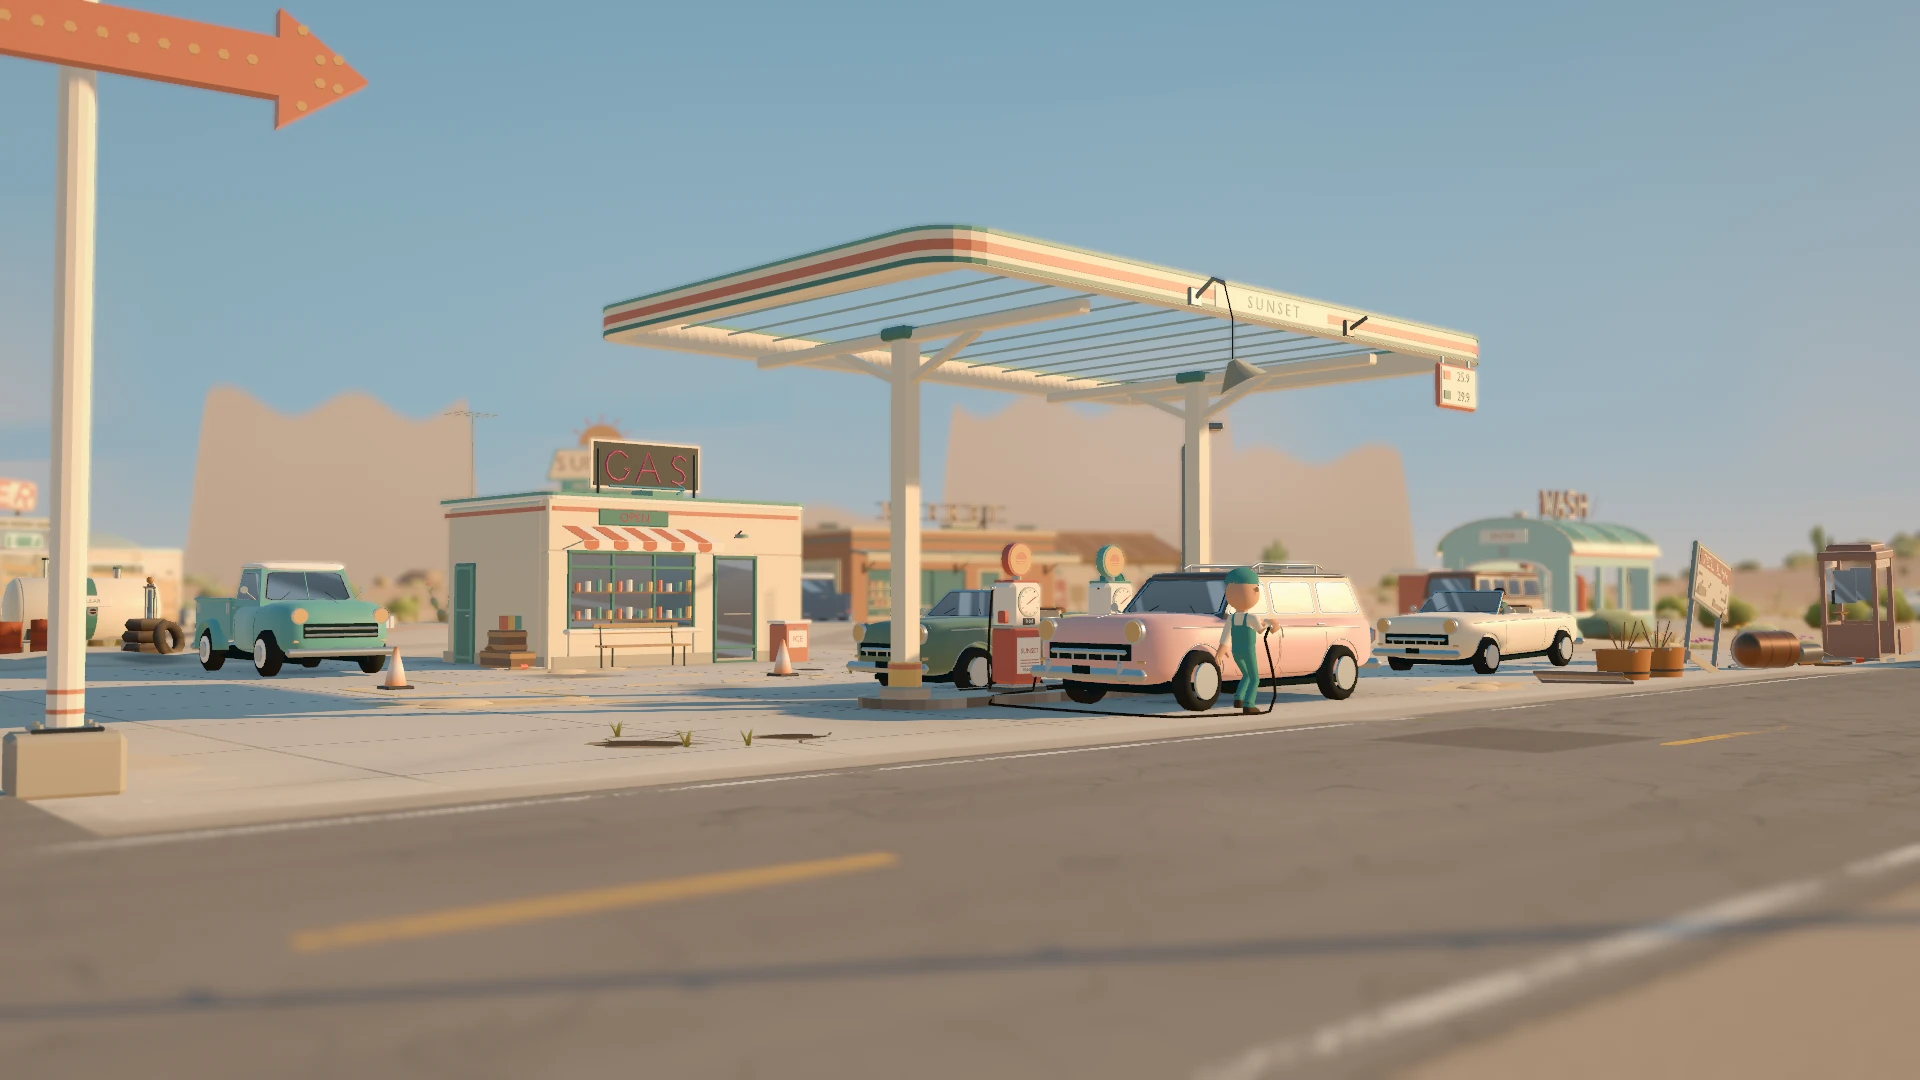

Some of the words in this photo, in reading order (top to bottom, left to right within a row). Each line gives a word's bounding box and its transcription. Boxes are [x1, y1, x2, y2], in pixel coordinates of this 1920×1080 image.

[1247, 295, 1300, 318] SUNSET
[1456, 371, 1470, 383] 25.9
[1457, 390, 1470, 402] 29.9
[605, 449, 687, 485] GAS
[1538, 489, 1588, 519] WASH
[619, 511, 651, 524] OPEN
[792, 635, 804, 643] ICE
[1020, 647, 1039, 655] SUNSET
